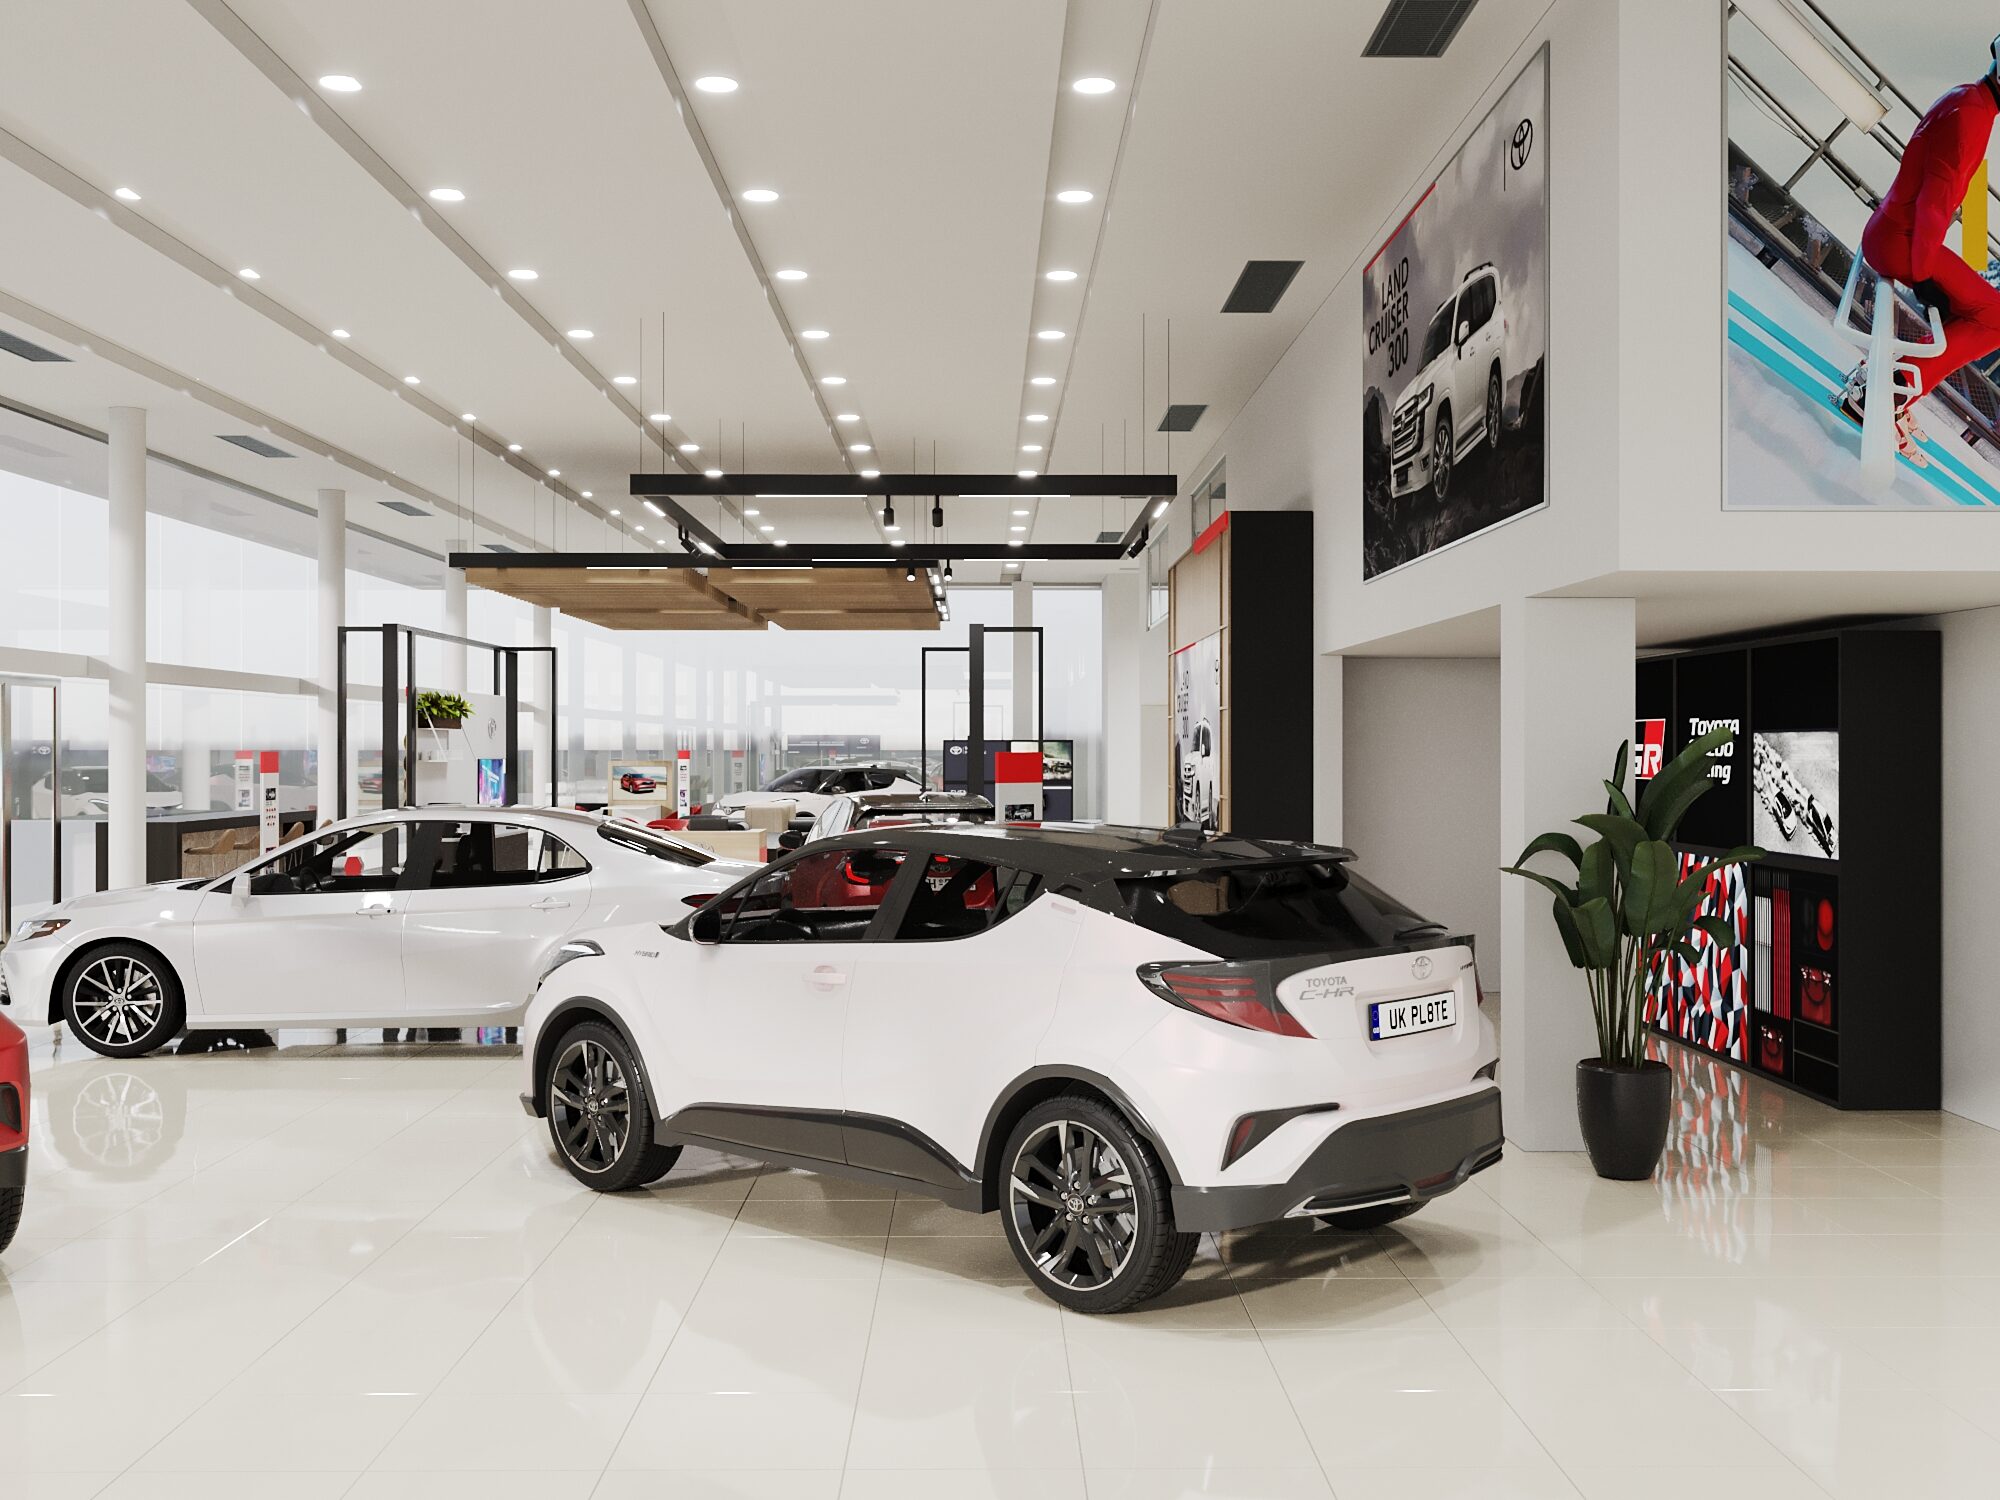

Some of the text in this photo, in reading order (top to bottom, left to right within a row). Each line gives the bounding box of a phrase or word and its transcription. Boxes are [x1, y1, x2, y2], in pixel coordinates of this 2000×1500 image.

[1382, 257, 1409, 310] LAND
[1369, 291, 1409, 355] CRUISER
[1388, 327, 1409, 377] 300
[1300, 987, 1355, 1000] C-HR
[1306, 976, 1348, 988] TOYOTA
[1389, 1000, 1448, 1030] UK PL8TE
